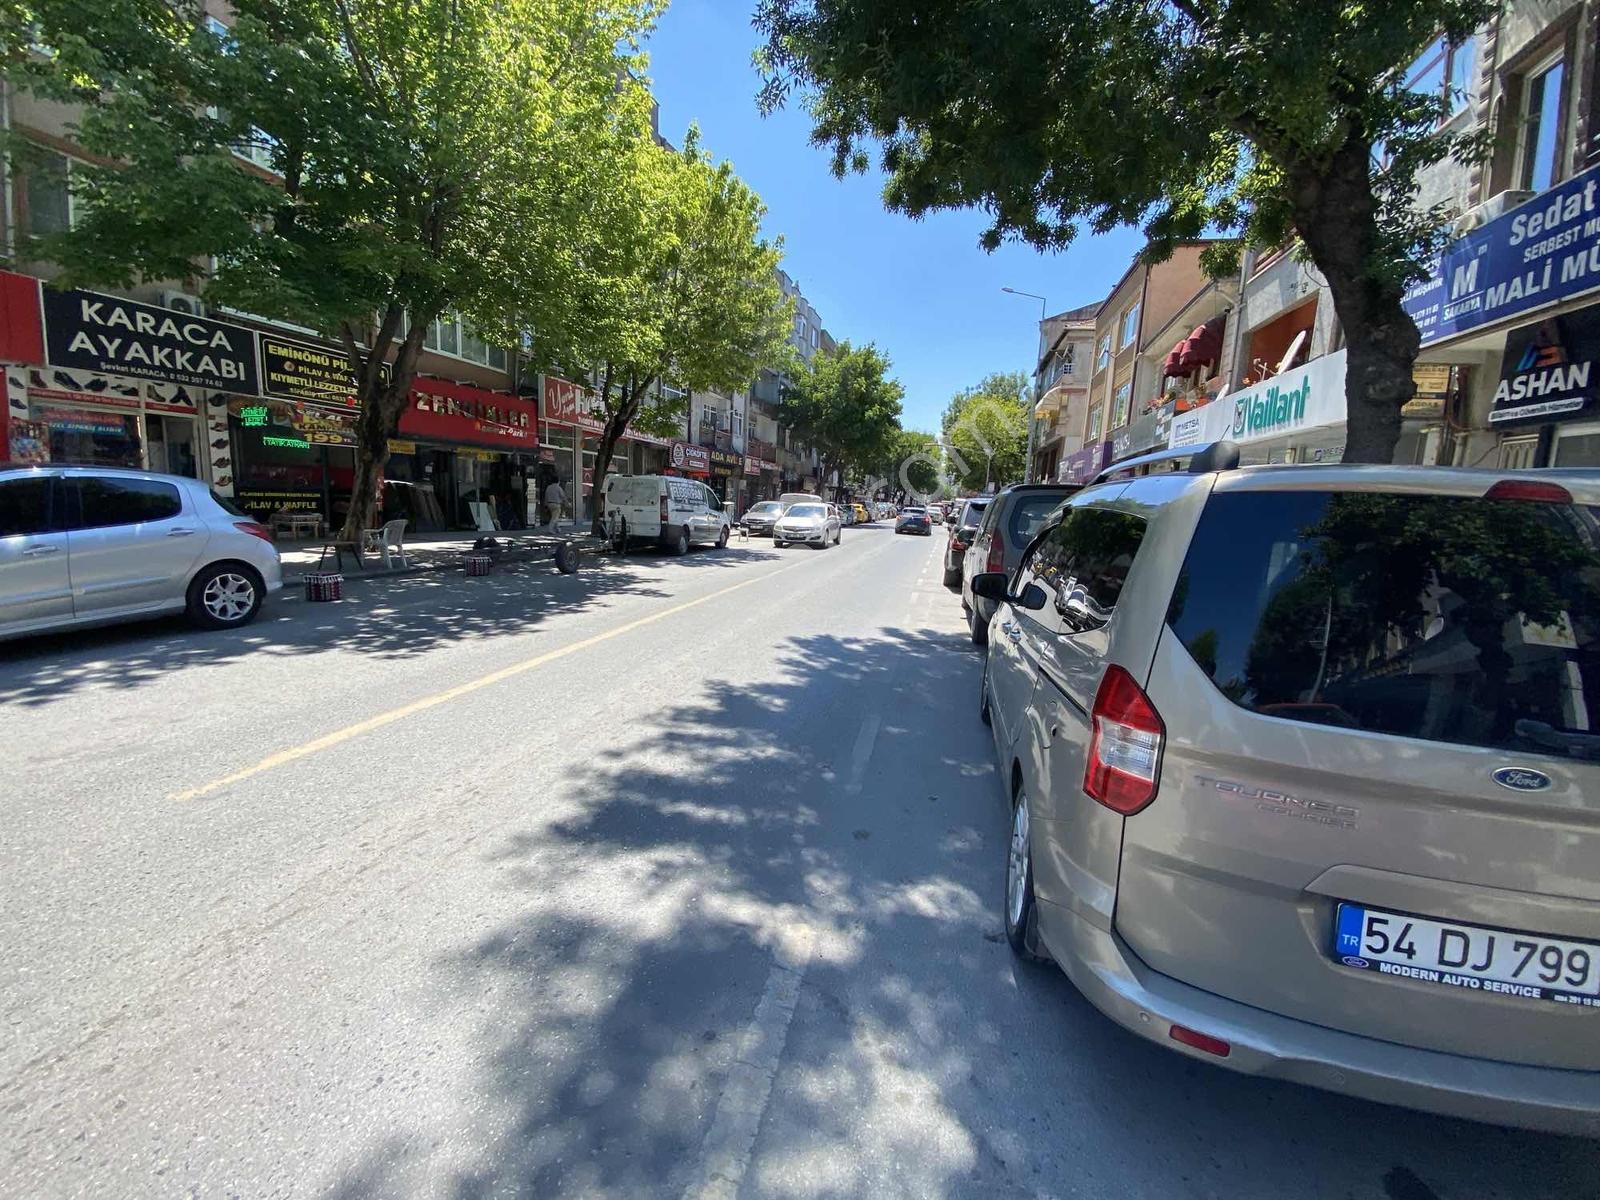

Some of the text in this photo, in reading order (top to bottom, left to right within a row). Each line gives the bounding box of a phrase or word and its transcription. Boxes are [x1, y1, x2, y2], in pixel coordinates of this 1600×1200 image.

[1509, 180, 1598, 246] Sedat
[1523, 225, 1582, 263] SERBEST
[1484, 258, 1553, 311] MALİ
[82, 299, 233, 351] KARACA
[68, 331, 246, 381] AYAKKABI
[268, 344, 330, 366] EMİNÖNÜ
[298, 365, 322, 377] PİLAV
[1246, 375, 1311, 432] Vaillant
[1492, 361, 1591, 404] ASHAN
[304, 434, 343, 444] 199
[1506, 770, 1541, 790] Ford
[1342, 916, 1590, 987] TR 54 DJ 799
[1379, 962, 1440, 982] MODERN
[1442, 975, 1480, 989] AUTO
